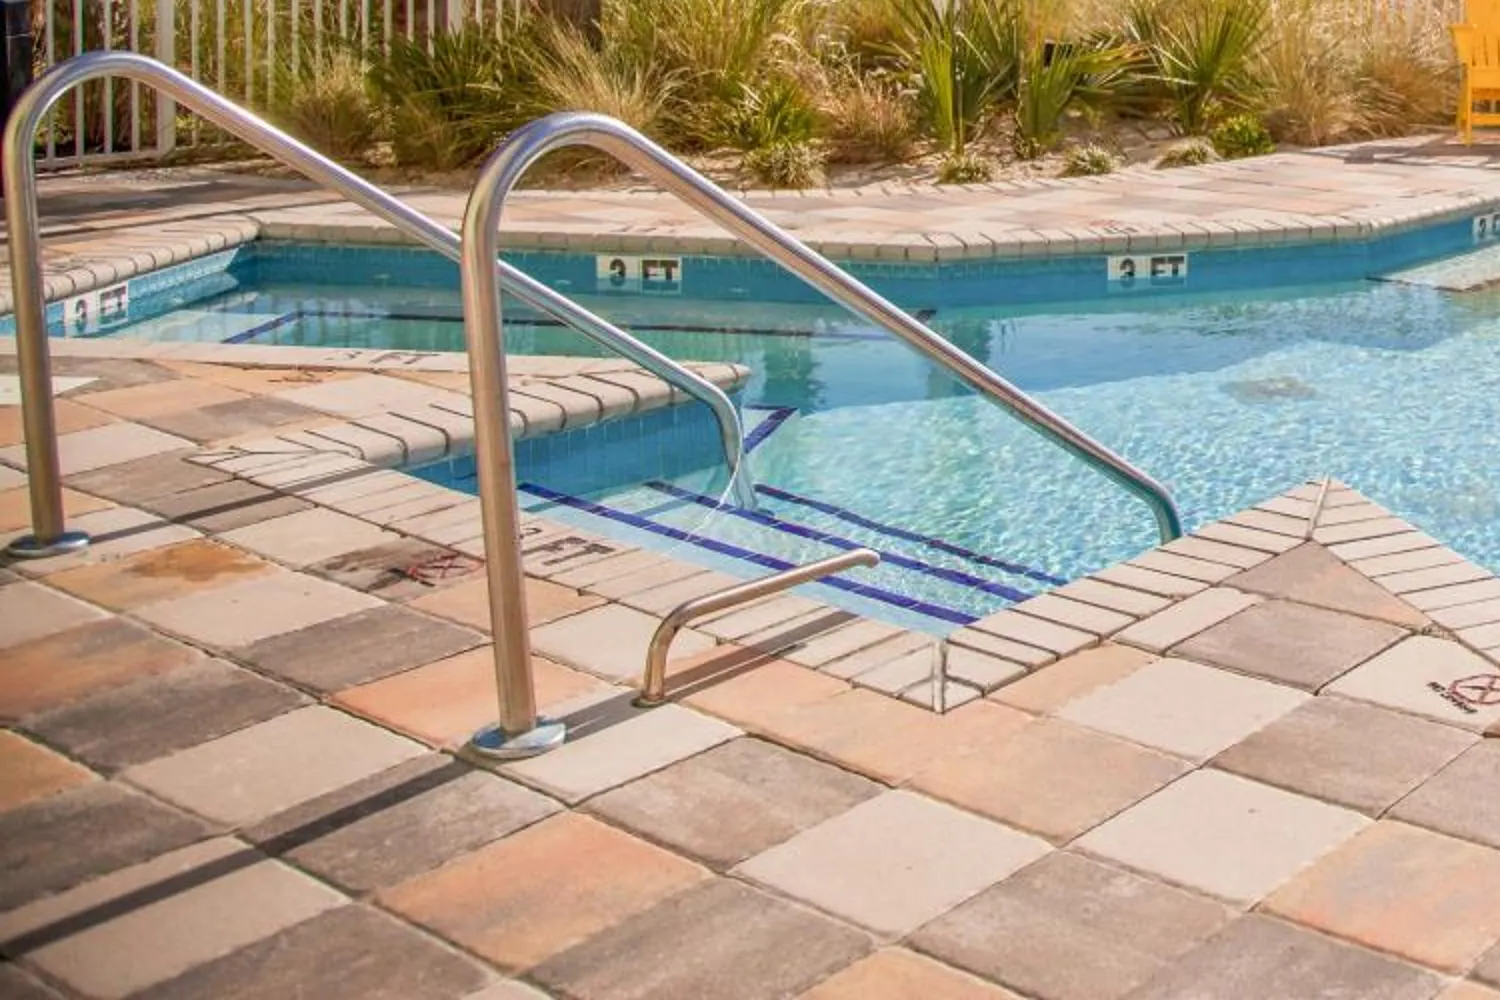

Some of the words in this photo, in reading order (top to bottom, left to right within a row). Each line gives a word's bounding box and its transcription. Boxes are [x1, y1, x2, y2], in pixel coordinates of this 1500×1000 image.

[609, 258, 626, 281] 3
[642, 260, 679, 281] FT
[1120, 258, 1136, 280] 3
[1150, 256, 1185, 278] FT
[521, 536, 617, 567] FT
